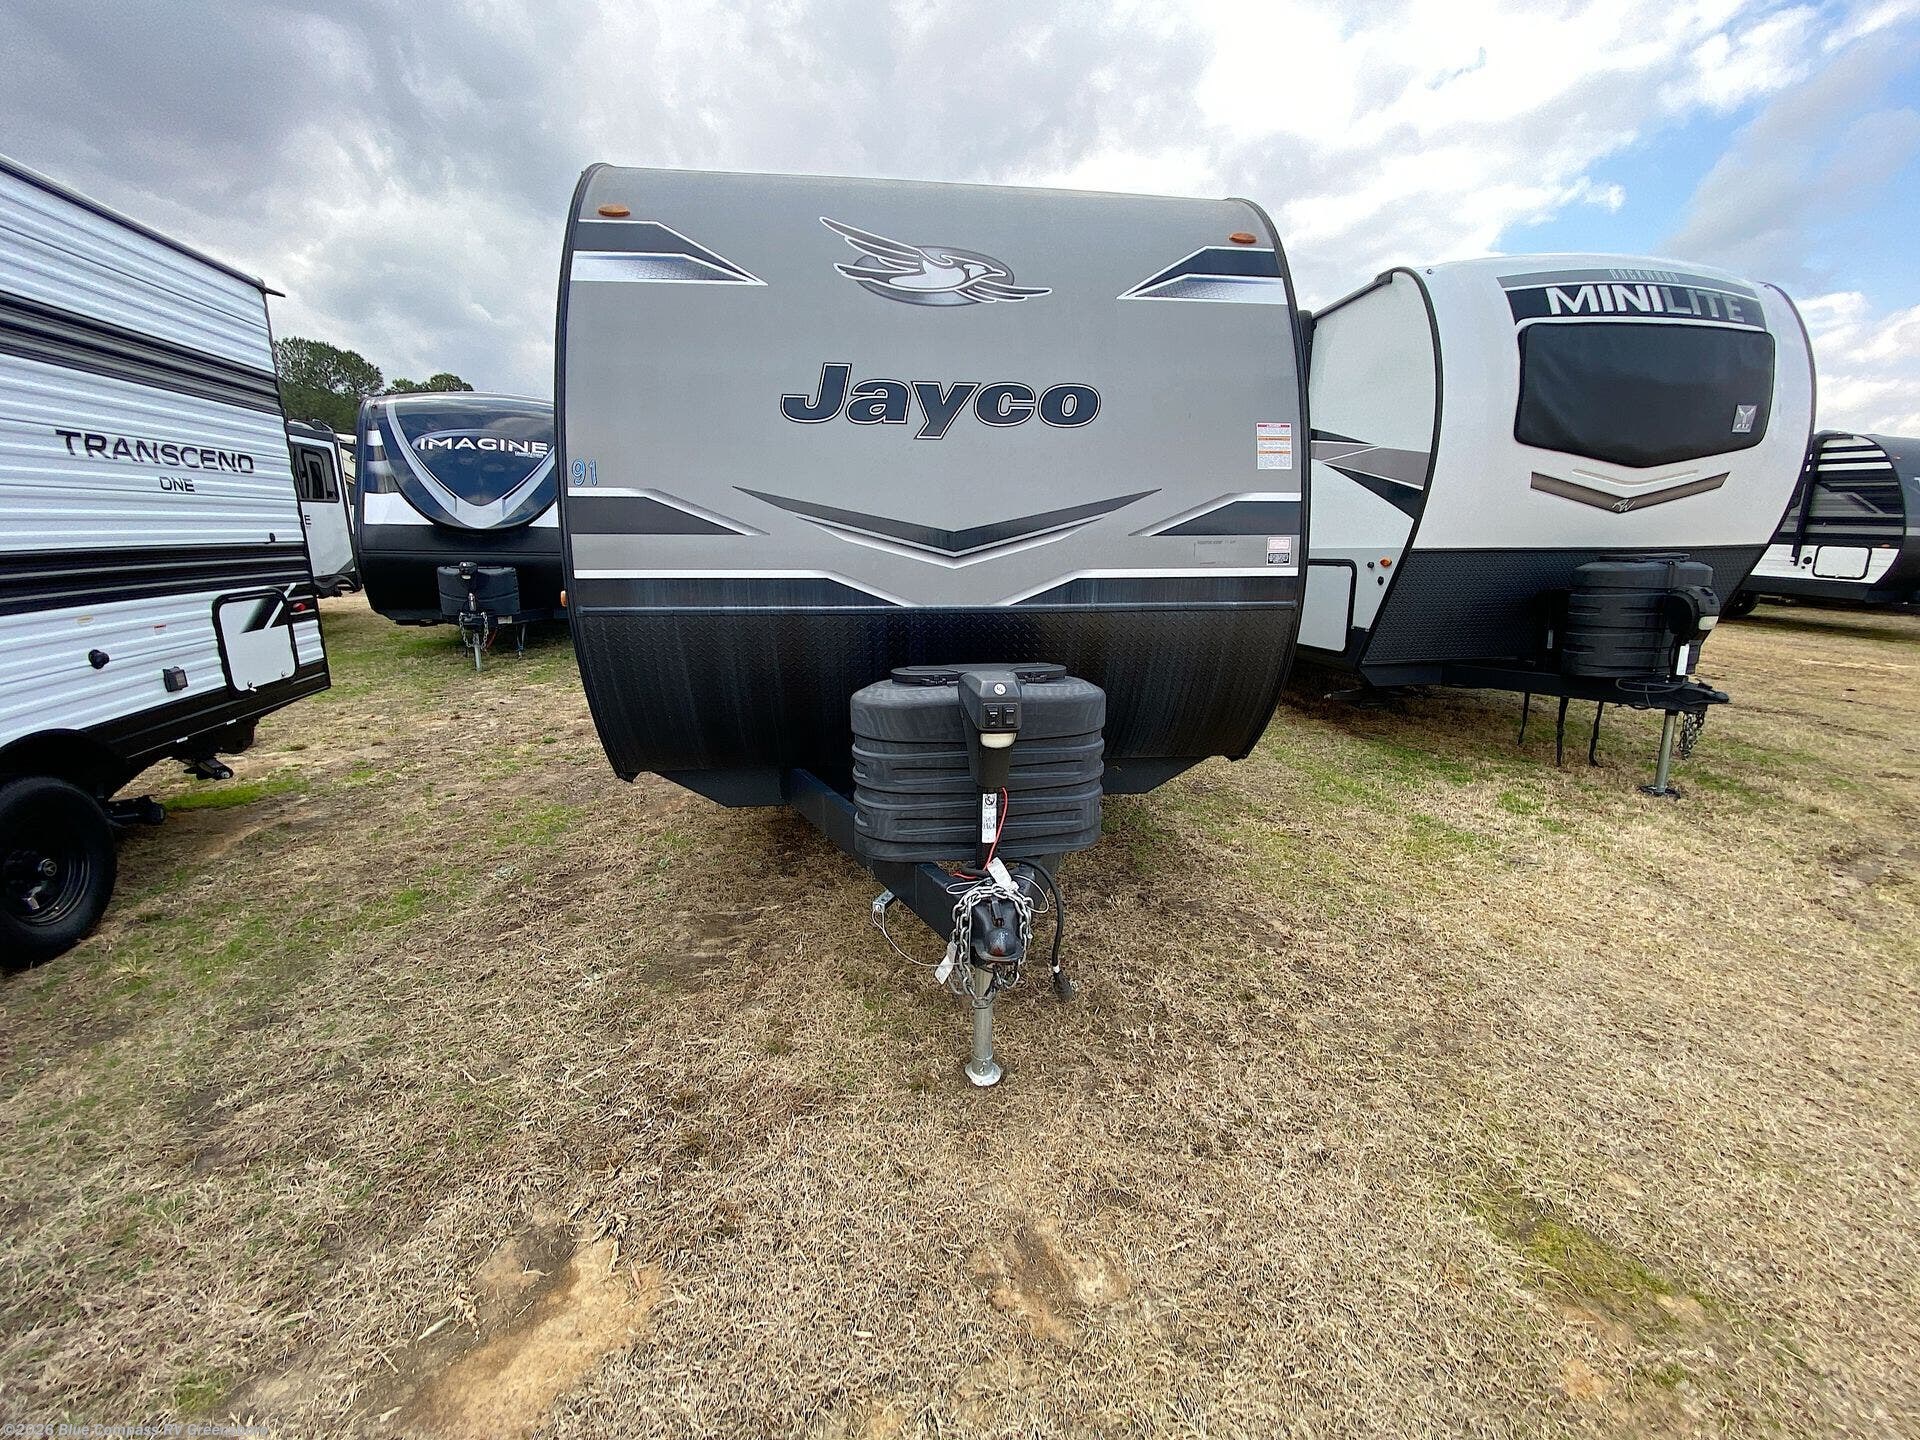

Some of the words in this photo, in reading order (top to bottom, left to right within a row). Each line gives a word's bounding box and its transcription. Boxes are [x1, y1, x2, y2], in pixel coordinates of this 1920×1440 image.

[780, 361, 1102, 440] Jayco
[55, 429, 255, 474] TRANSCEND
[420, 437, 549, 455] IMAGINE
[159, 476, 196, 493] ONE
[571, 459, 598, 487] 91
